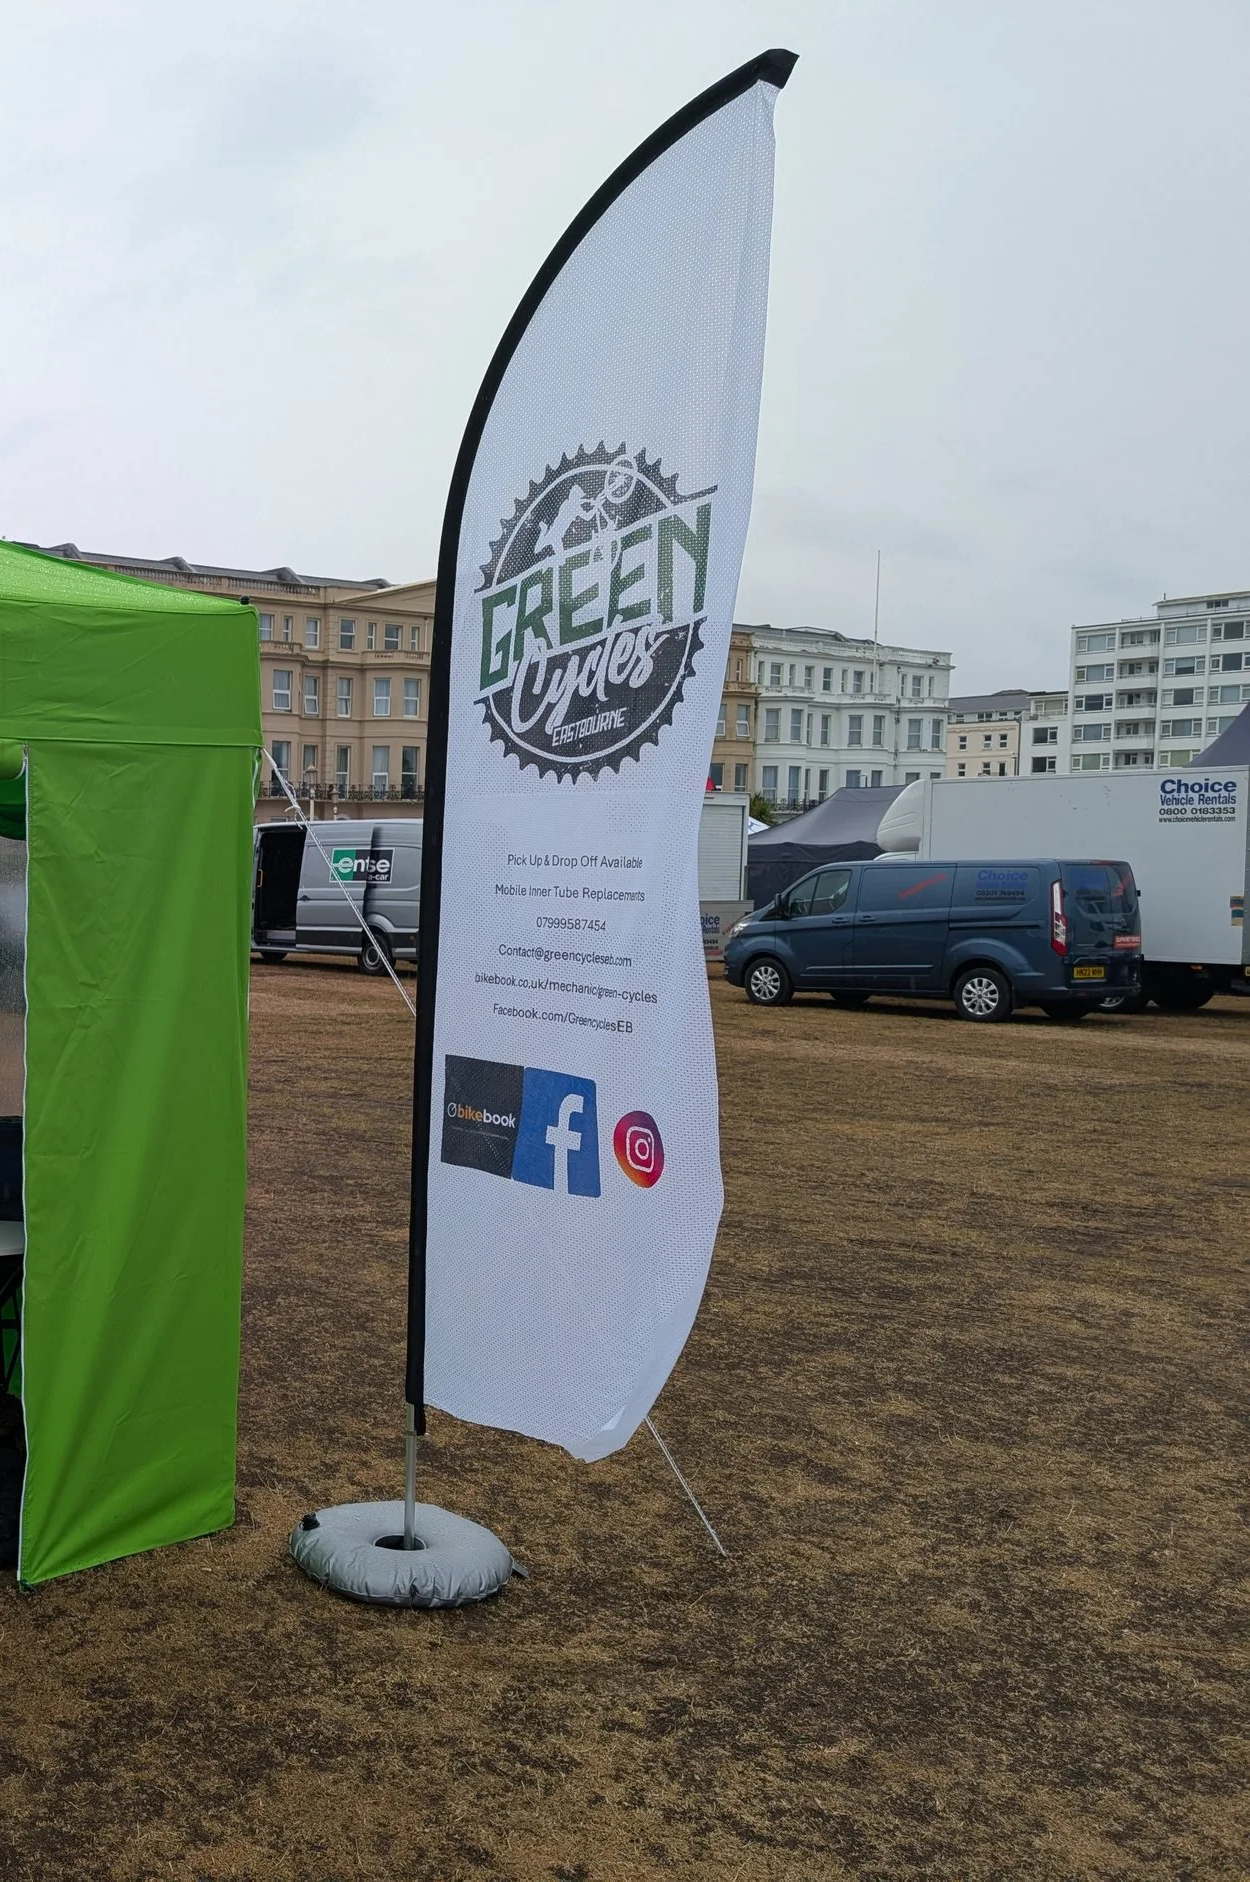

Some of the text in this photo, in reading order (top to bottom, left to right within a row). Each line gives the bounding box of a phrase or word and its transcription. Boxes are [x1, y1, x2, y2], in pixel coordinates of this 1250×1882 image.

[479, 500, 713, 692] GREEN
[511, 615, 669, 735] Cycles
[552, 707, 627, 747] EASTBOURNE
[1160, 778, 1237, 794] Choice
[1160, 793, 1237, 806] Vehicle Rentals
[507, 854, 643, 869] Pick Up & Drop Off Available
[977, 869, 1029, 881] Choice
[495, 883, 646, 902] Mobile Inner Tube Replacements
[536, 916, 606, 931] 07999587454
[700, 913, 720, 925] oice
[498, 943, 632, 967] Contact@greencycleseb.com
[474, 972, 658, 1004] bikebook.co.uk/mechanic/green-cycles
[493, 1003, 633, 1033] Facebook.com/GreencyclesEB
[456, 1103, 517, 1129] bikebook
